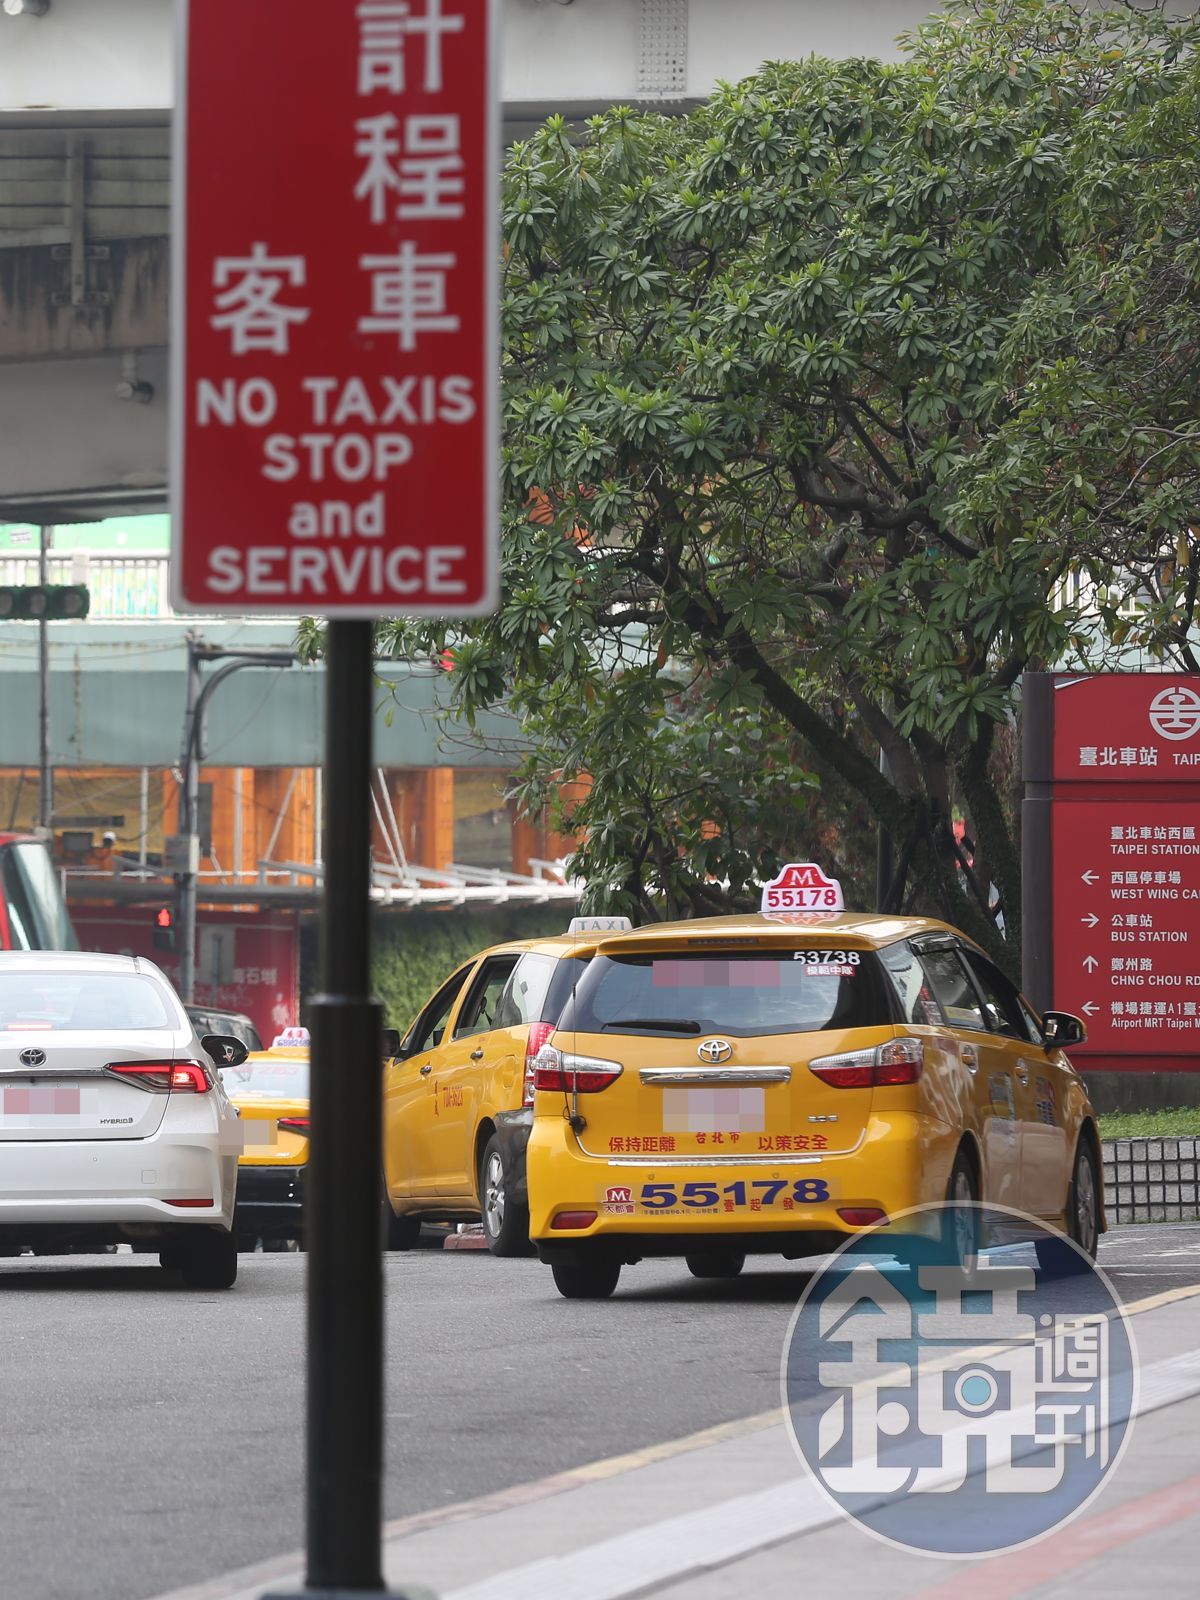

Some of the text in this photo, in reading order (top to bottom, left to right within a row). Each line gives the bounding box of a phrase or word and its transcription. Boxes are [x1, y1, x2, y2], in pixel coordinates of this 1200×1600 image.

[209, 242, 310, 355] 客
[196, 375, 476, 427] NO TAXIS
[261, 433, 413, 482] STOP
[288, 491, 385, 538] and
[205, 546, 467, 594] SERVICE
[1079, 746, 1158, 766] 臺北車站
[1110, 826, 1196, 840] 臺北車站西區
[1110, 844, 1200, 855] TAIPEI STATION
[1110, 871, 1182, 885] 西區停車場
[767, 889, 837, 907] 55178
[1110, 889, 1200, 899] WEST WING CA
[578, 920, 625, 931] TAXI
[1111, 914, 1153, 927] 公車站
[1111, 931, 1188, 942] BUS STATION
[793, 951, 861, 965] 53738
[1111, 957, 1153, 971] 鄭州路
[1111, 975, 1145, 986] CHNG
[1148, 975, 1182, 986] CHOU
[1110, 1001, 1200, 1016] 機場捷運A1臺
[1111, 1017, 1142, 1030] Airport
[1144, 1017, 1164, 1028] MRT
[1166, 1017, 1192, 1030] Taipei
[608, 1136, 676, 1152] 保持距離
[757, 1135, 829, 1151] 以策安全
[640, 1178, 831, 1209] 55178
